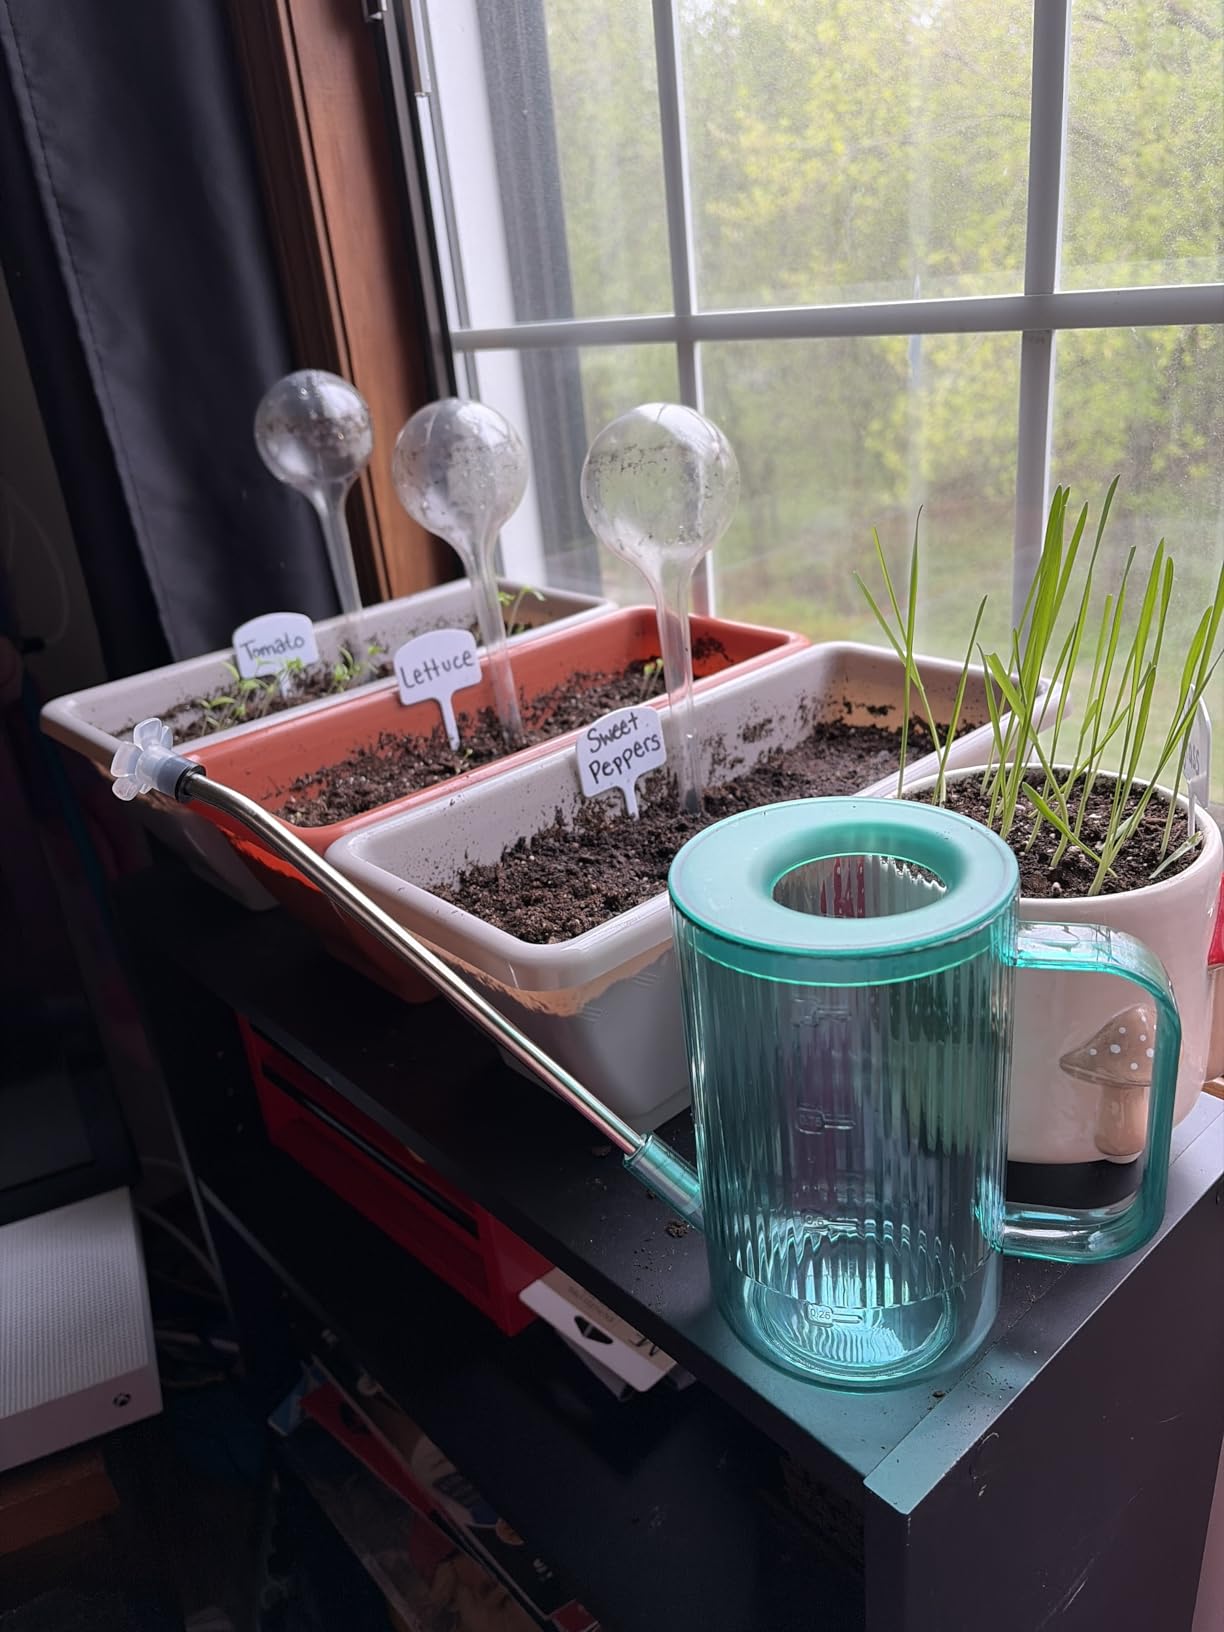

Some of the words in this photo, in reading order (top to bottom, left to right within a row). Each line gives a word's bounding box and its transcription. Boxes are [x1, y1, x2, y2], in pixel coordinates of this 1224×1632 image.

[240, 632, 305, 660] Tomato
[399, 650, 475, 689] Lettuce
[587, 711, 639, 754] Sweet
[588, 734, 661, 784] Peppers
[810, 1308, 831, 1320] 0.25
